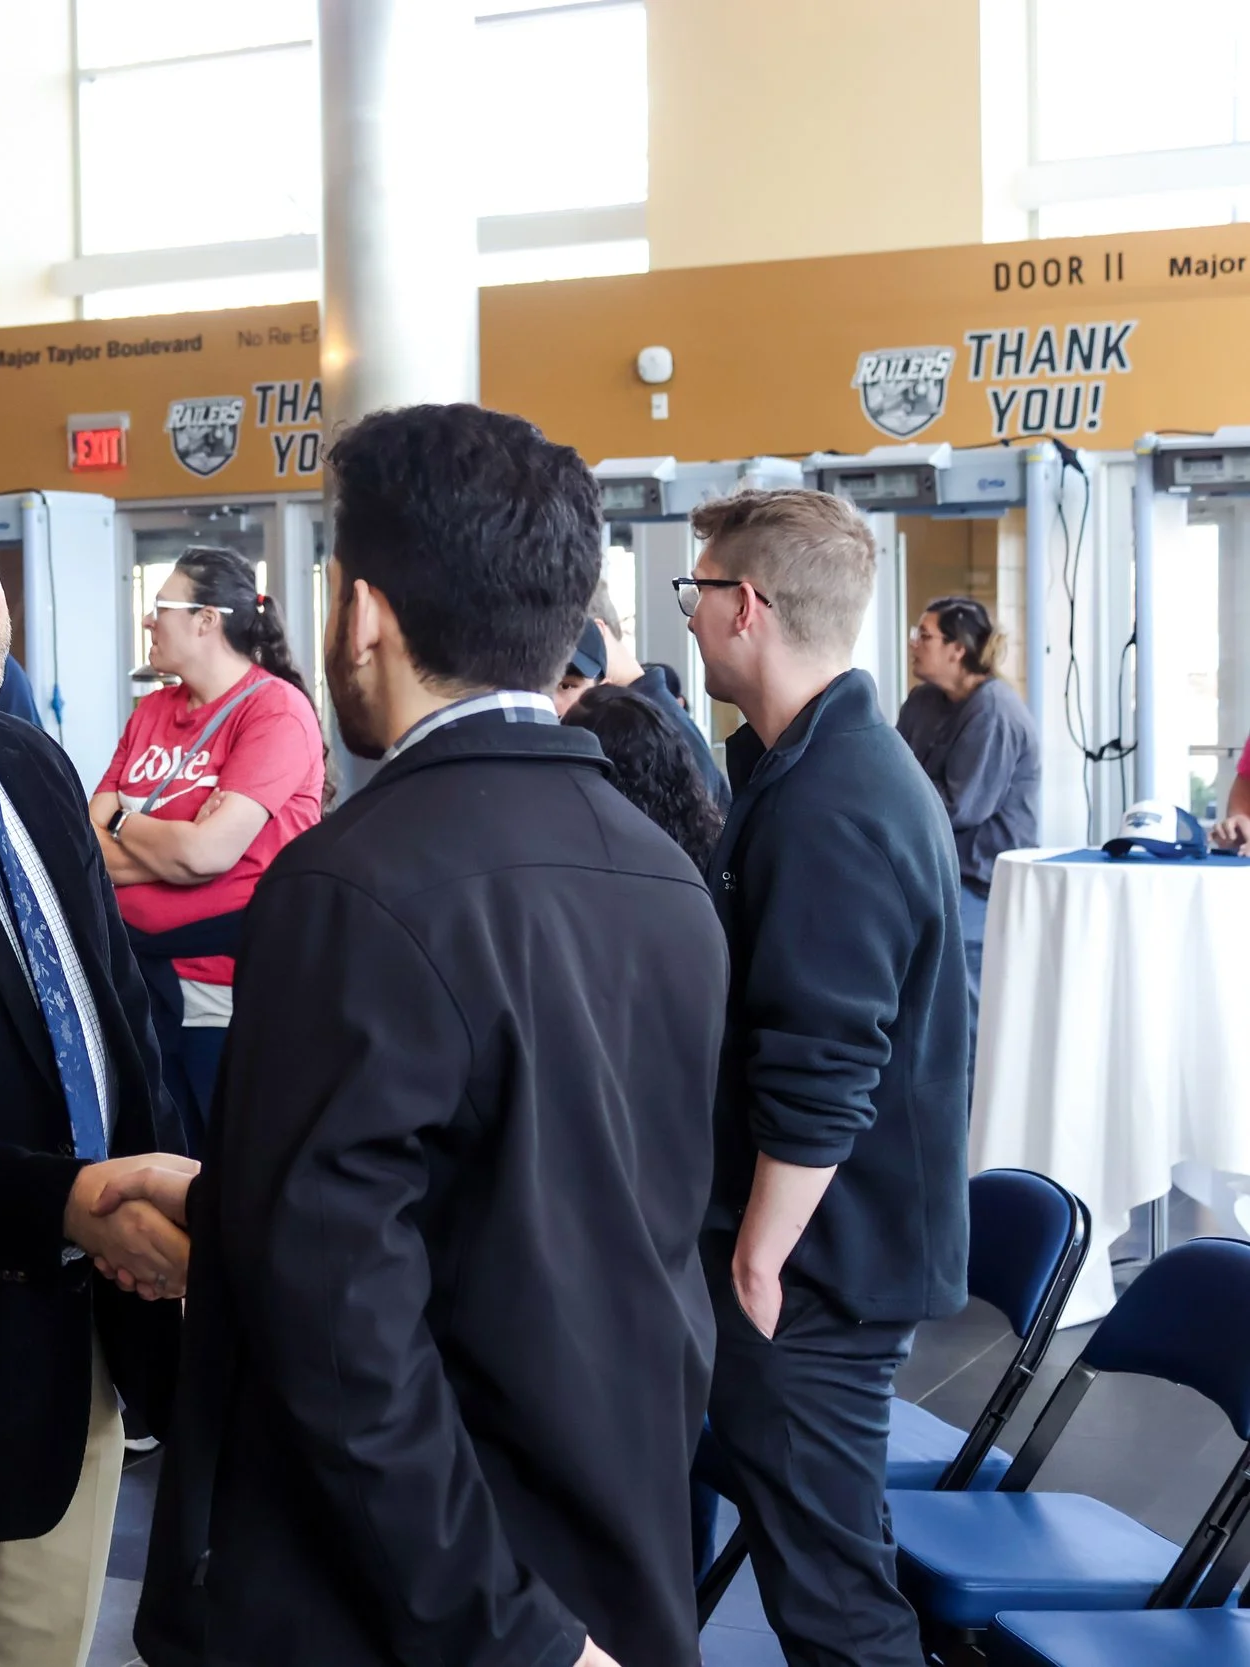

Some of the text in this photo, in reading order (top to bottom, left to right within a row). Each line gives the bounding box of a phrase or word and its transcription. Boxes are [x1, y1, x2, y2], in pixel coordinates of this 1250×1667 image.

[994, 256, 1084, 292] DOOR
[1169, 253, 1247, 280] Major
[47, 344, 101, 365] Taylor
[106, 335, 203, 359] Boulevard
[237, 328, 263, 348] No
[967, 325, 1135, 378] THANK
[856, 350, 952, 384] RAILERS
[168, 400, 243, 429] RAILERS
[991, 385, 1103, 434] YOU!
[76, 430, 120, 466] EXIT
